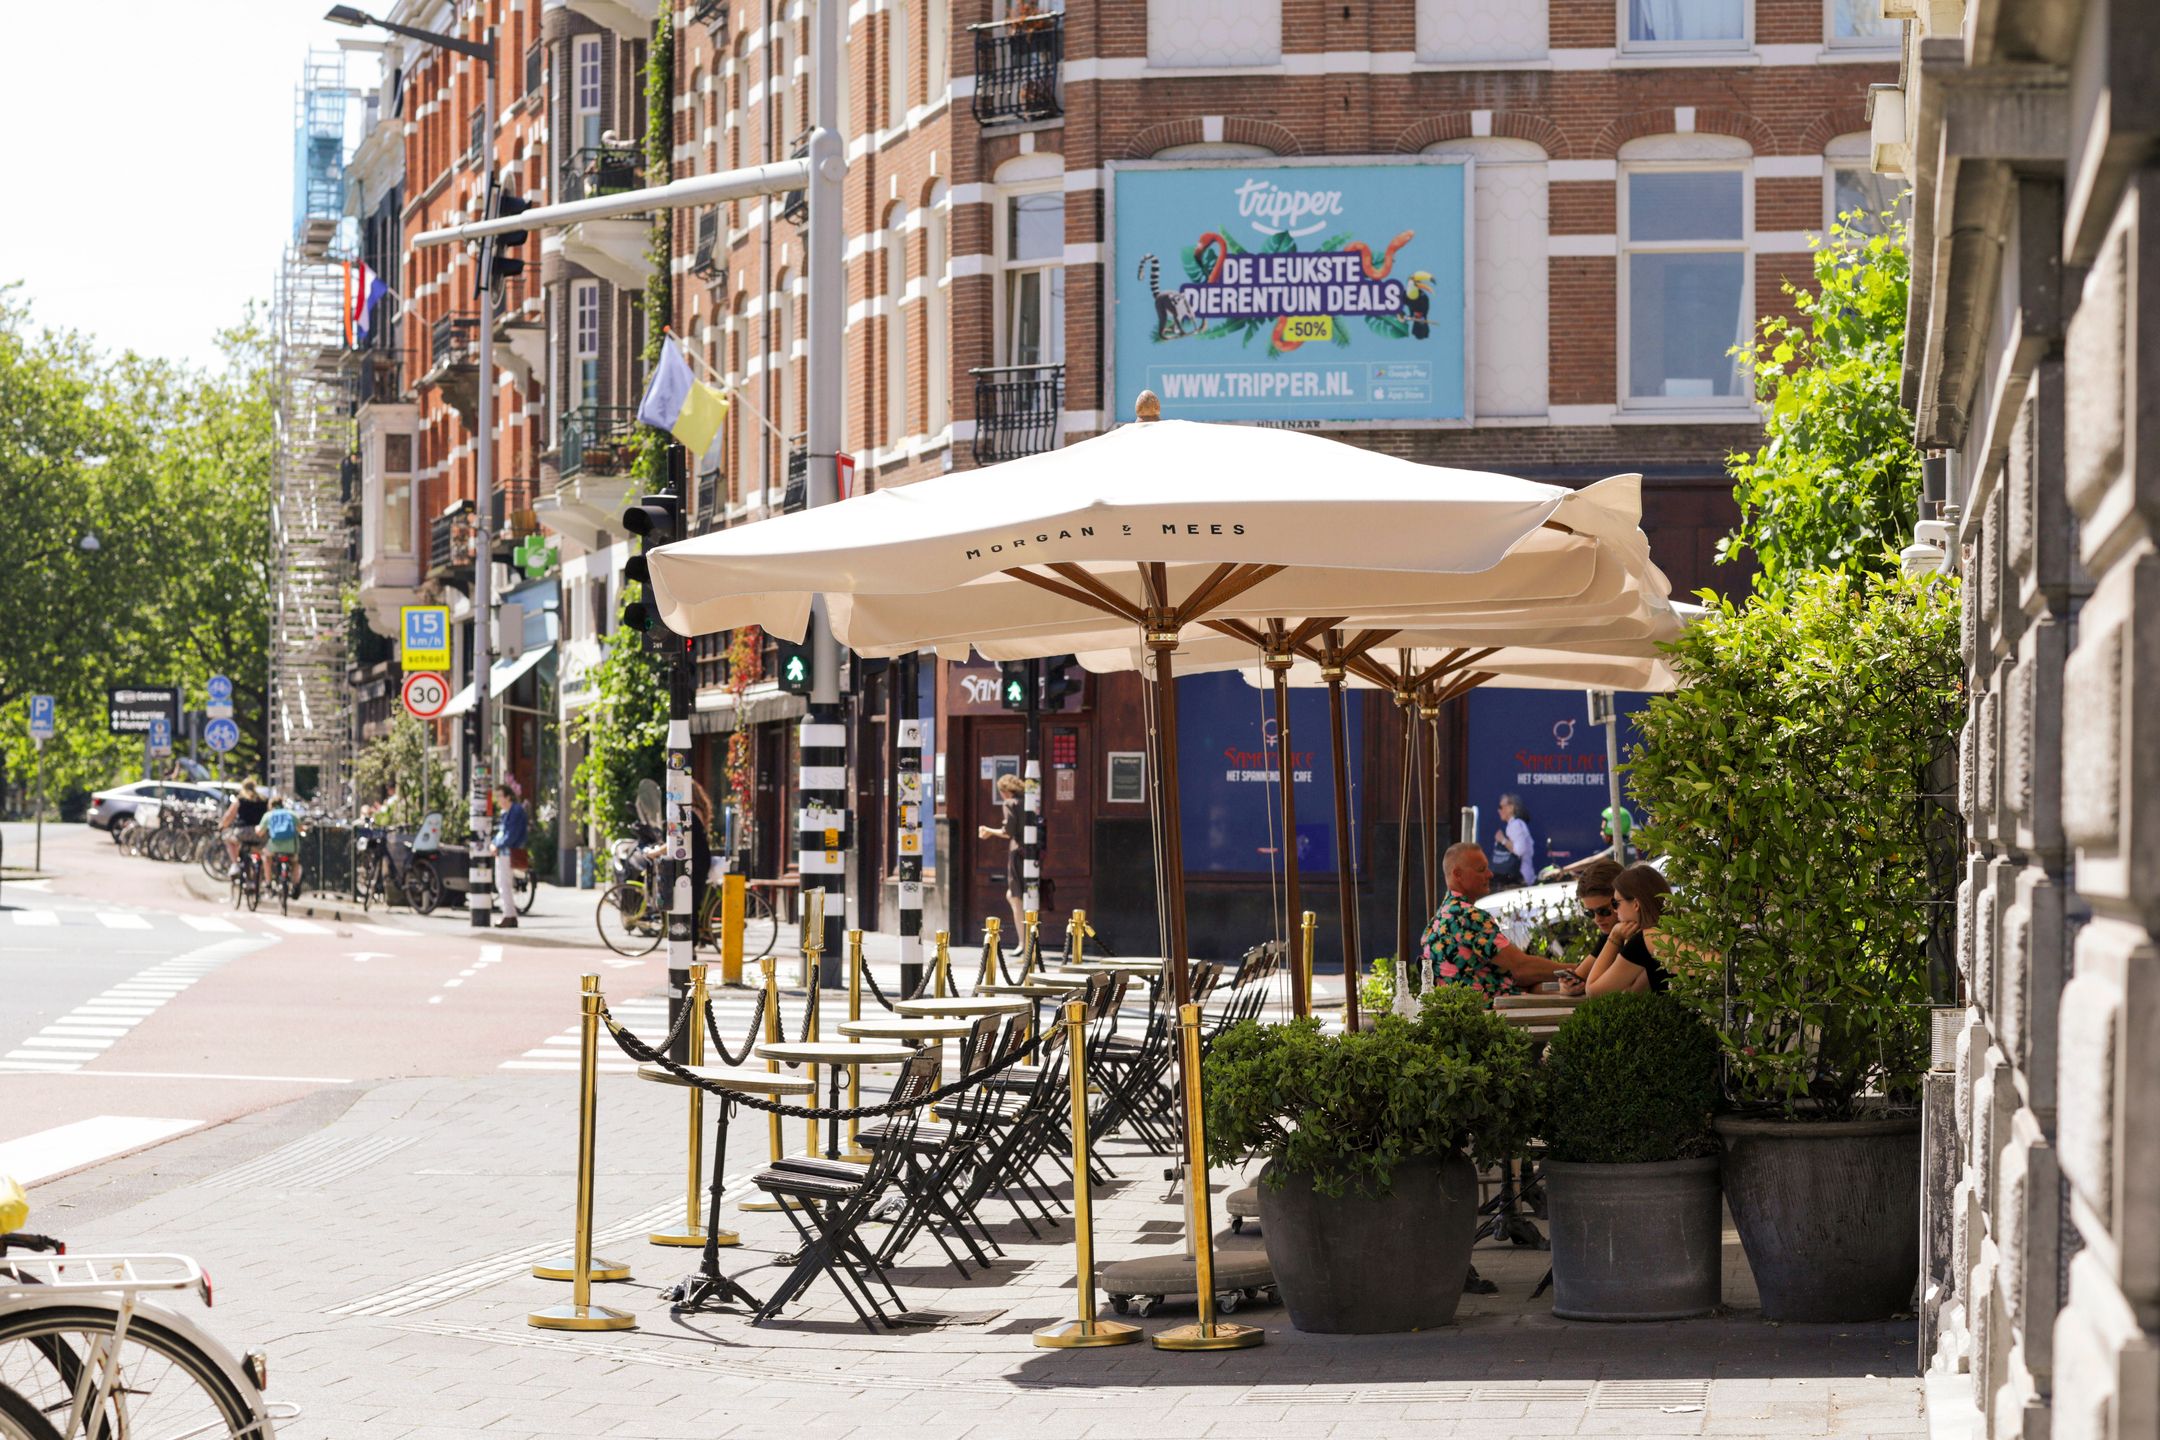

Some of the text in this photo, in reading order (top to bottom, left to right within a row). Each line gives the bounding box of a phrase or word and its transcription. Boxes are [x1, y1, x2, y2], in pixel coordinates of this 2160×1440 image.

[1234, 178, 1344, 228] tripper
[1222, 255, 1361, 285] DE LEUKSTE
[1183, 283, 1401, 314] DIERENTUIN DEALS
[1288, 321, 1327, 337] -50%
[1161, 371, 1354, 399] WWW.TRIPPER.NL
[1256, 419, 1321, 429] HILLENAAR
[966, 526, 1095, 560] MORGAN
[1162, 523, 1246, 536] MEES
[412, 613, 439, 634] 15
[410, 635, 442, 647] km/h
[408, 653, 445, 664] school
[412, 686, 441, 704] 30
[36, 699, 49, 717] P
[1226, 770, 1241, 782] HET
[1517, 773, 1532, 785] HET
